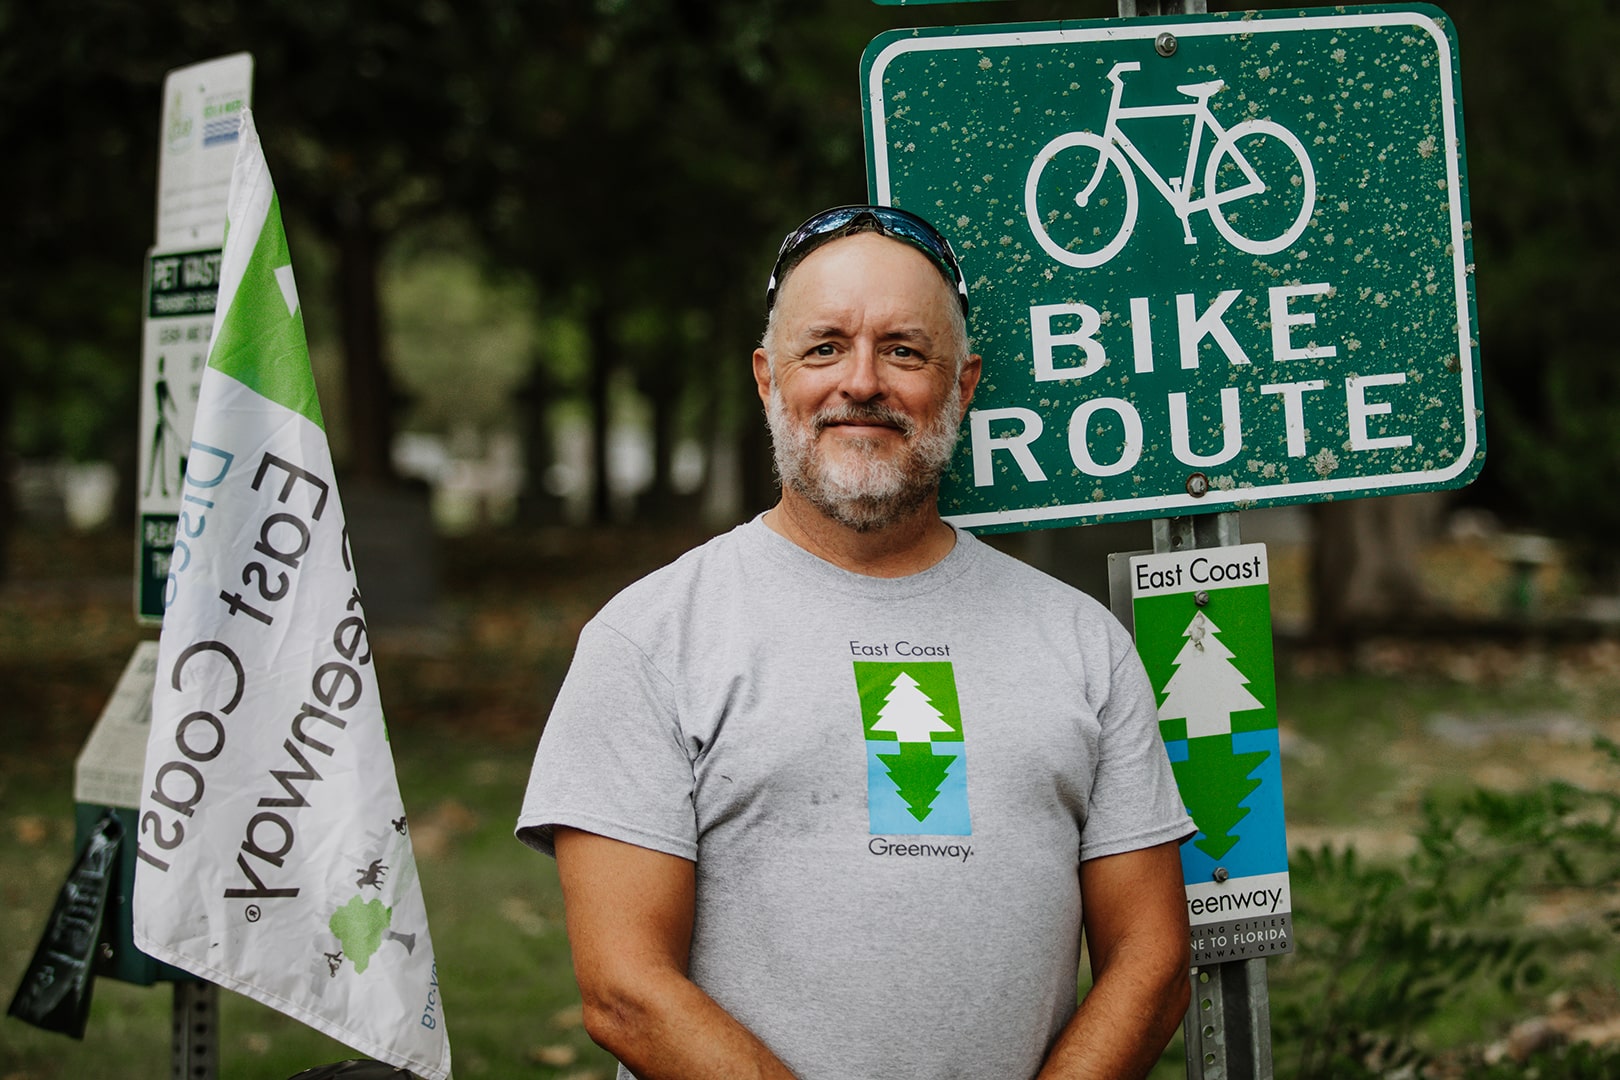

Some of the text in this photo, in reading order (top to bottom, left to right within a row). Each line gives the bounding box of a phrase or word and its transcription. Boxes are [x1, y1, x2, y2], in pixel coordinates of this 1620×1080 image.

[183, 254, 221, 288] WAST
[1030, 282, 1337, 383] BIKE
[970, 372, 1413, 487] ROUTE
[1136, 556, 1260, 590] East Coast
[849, 640, 950, 656] East Coast
[1187, 888, 1282, 915] eenway
[1190, 918, 1285, 937] KING CITIES
[1211, 936, 1227, 948] TO
[1233, 928, 1286, 945] FLORIDA
[1195, 941, 1286, 960] ENWAY.ORG
